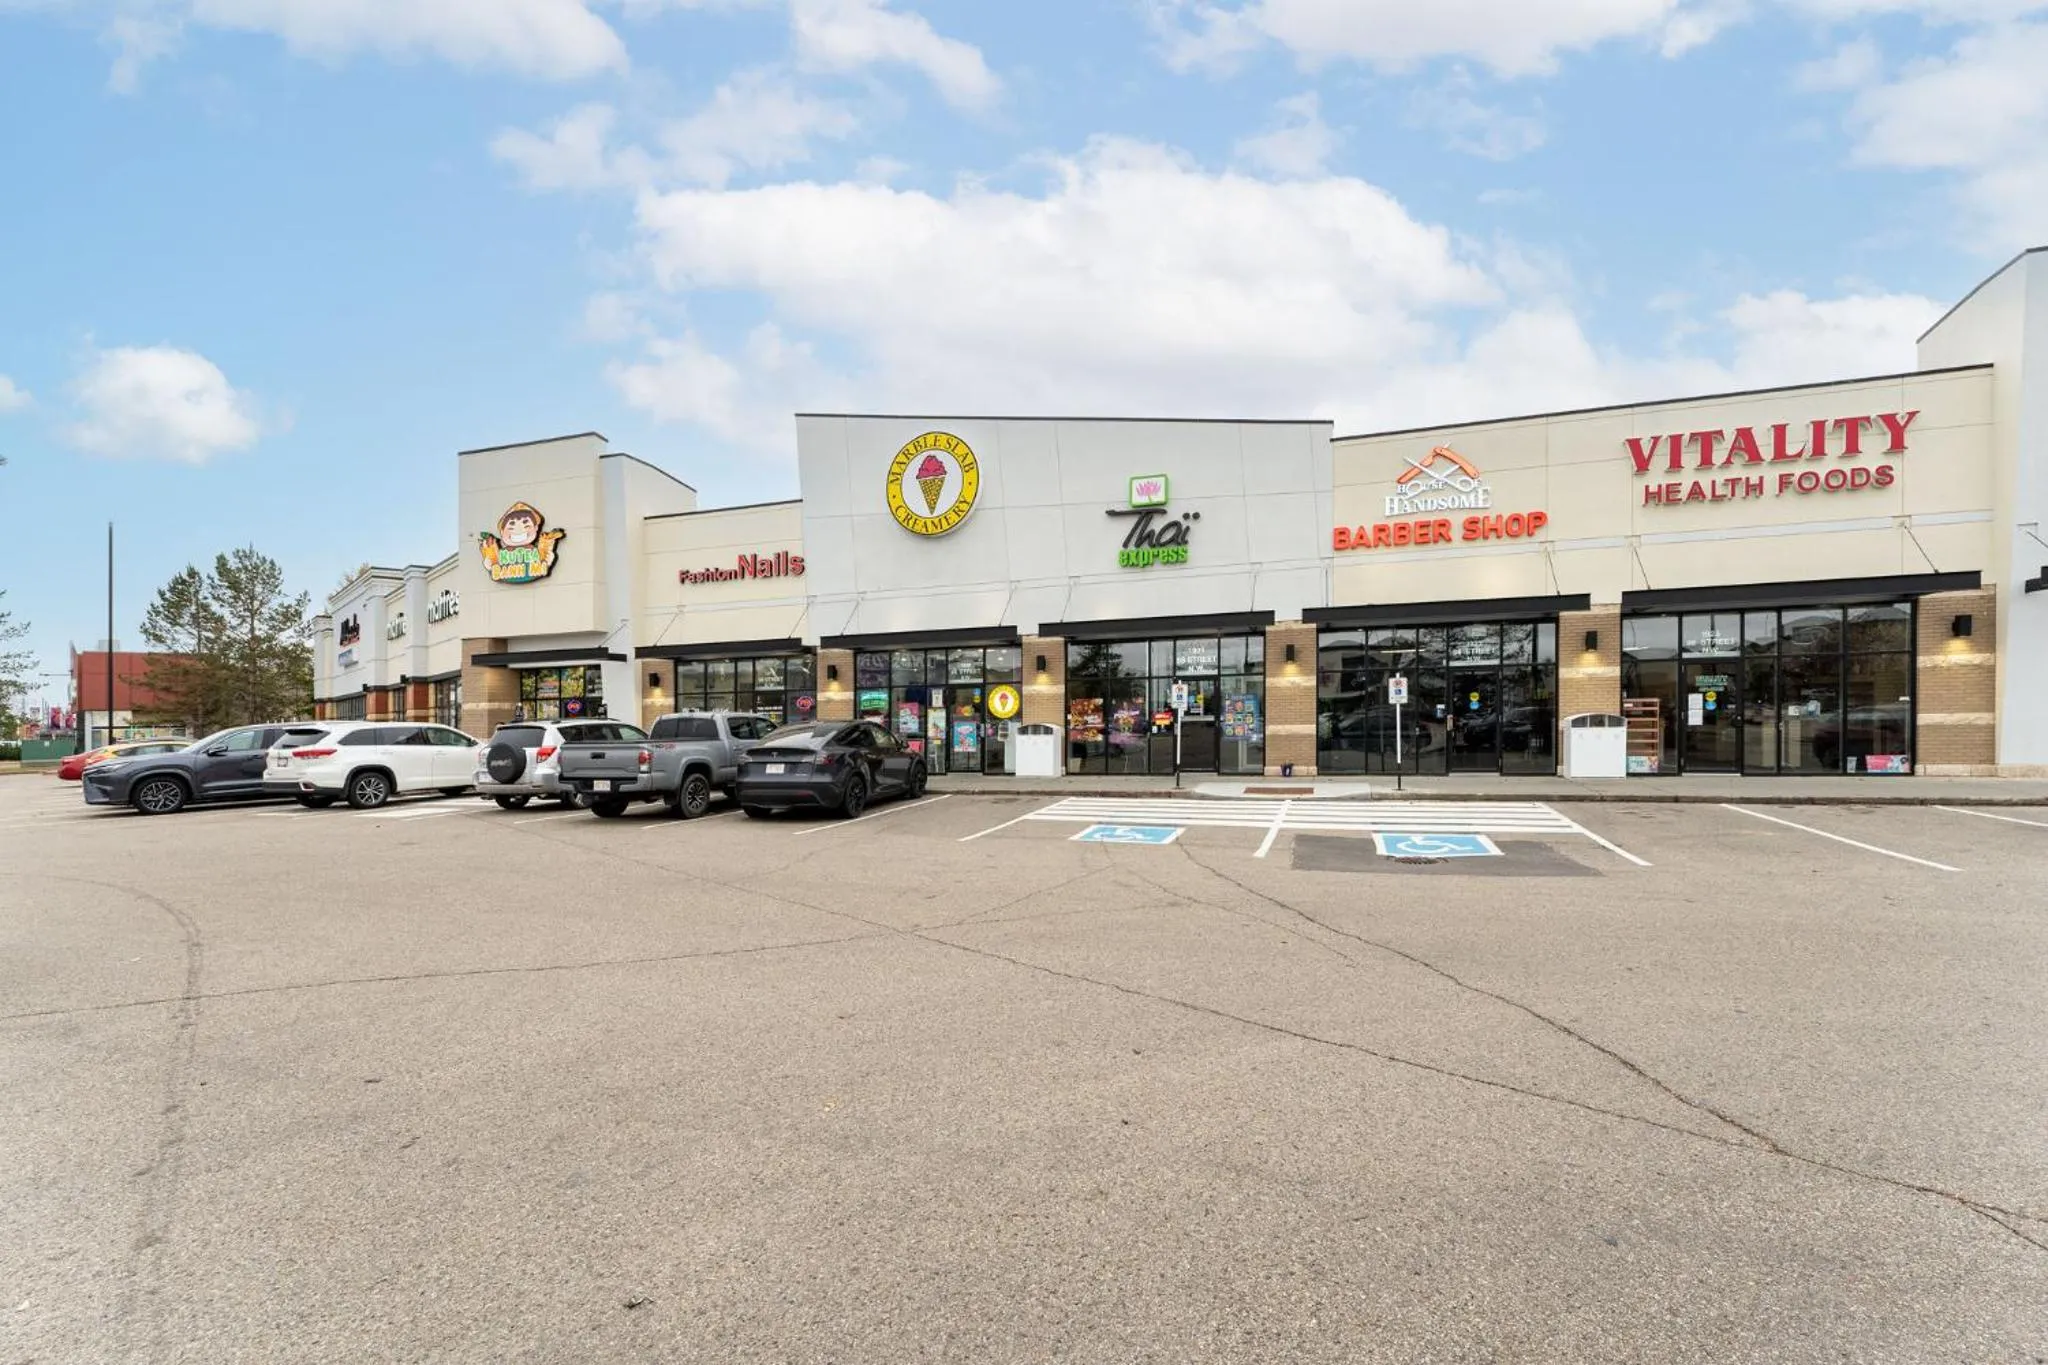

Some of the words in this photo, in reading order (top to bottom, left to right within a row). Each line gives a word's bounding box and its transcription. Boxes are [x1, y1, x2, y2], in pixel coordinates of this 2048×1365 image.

[890, 434, 942, 484] MARBLE
[945, 437, 975, 473] SLAB
[1624, 410, 1921, 474] VITALITY
[1384, 486, 1493, 516] HANDSOME
[1643, 475, 1765, 506] HEALTH
[1776, 464, 1896, 497] FOODS
[895, 496, 970, 533] CREAMERY
[1333, 517, 1453, 550] BARBER
[1462, 511, 1549, 541] SHOP
[679, 567, 738, 584] Fashion
[737, 551, 805, 580] Nails
[1118, 546, 1189, 568] express
